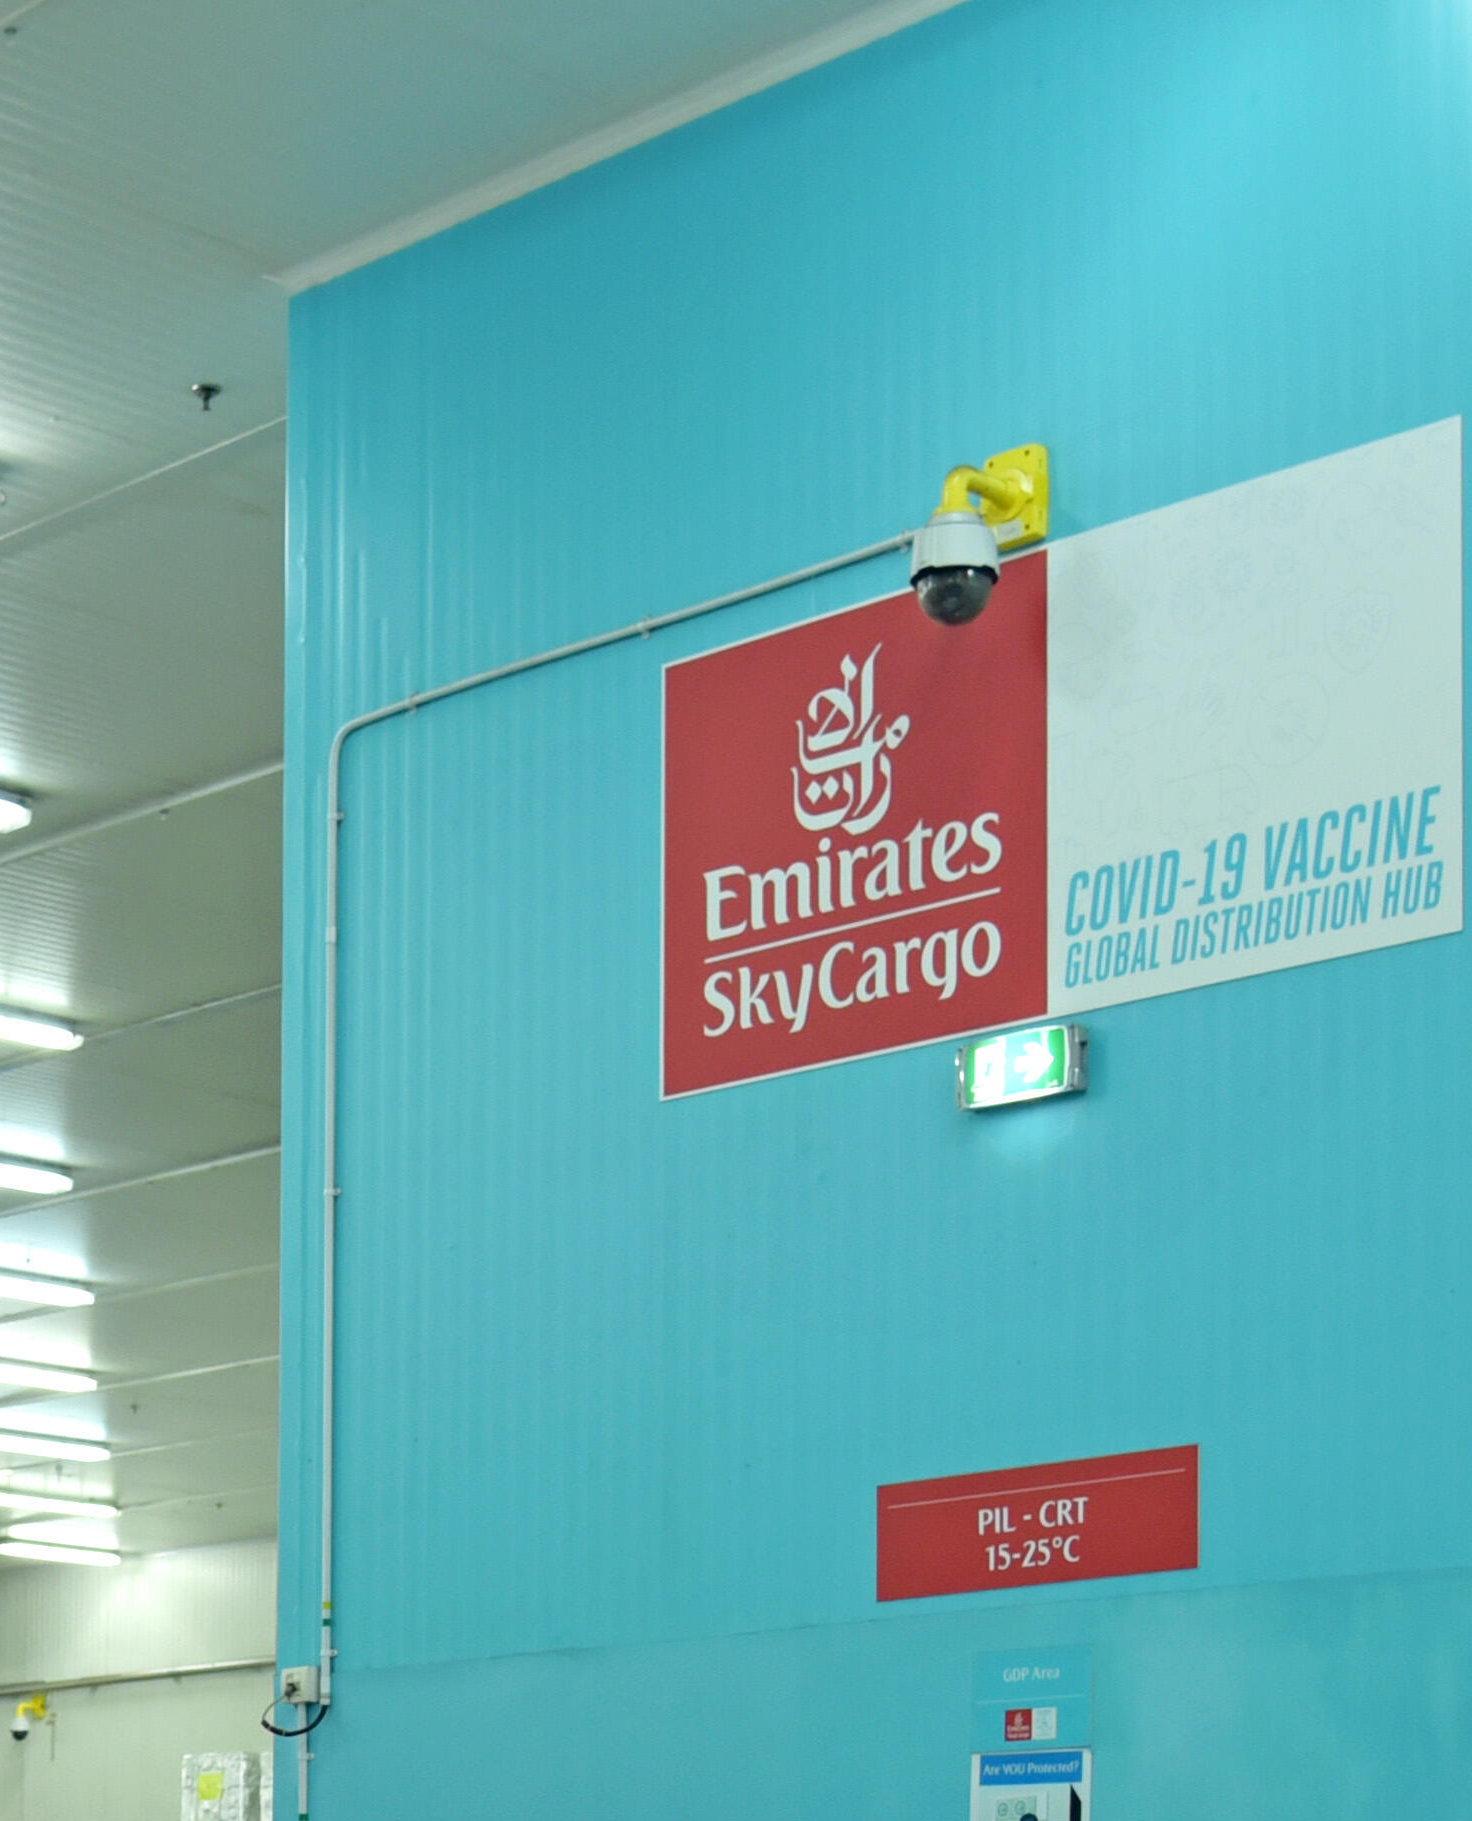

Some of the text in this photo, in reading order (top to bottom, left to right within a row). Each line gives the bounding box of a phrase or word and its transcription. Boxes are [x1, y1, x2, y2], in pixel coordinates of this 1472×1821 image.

[703, 812, 1002, 942] Emirates
[1065, 785, 1442, 937] COVID-19 VACCINE
[1065, 860, 1444, 989] GLOBAL DISTRIBUTION HUB
[703, 919, 1001, 1039] SkyCargo
[977, 1506, 1016, 1536] PIL
[1039, 1496, 1089, 1528] CRT
[985, 1535, 1081, 1572] 15-25°C
[1003, 1666, 1060, 1683] GDP Area
[983, 1764, 1001, 1776] Are
